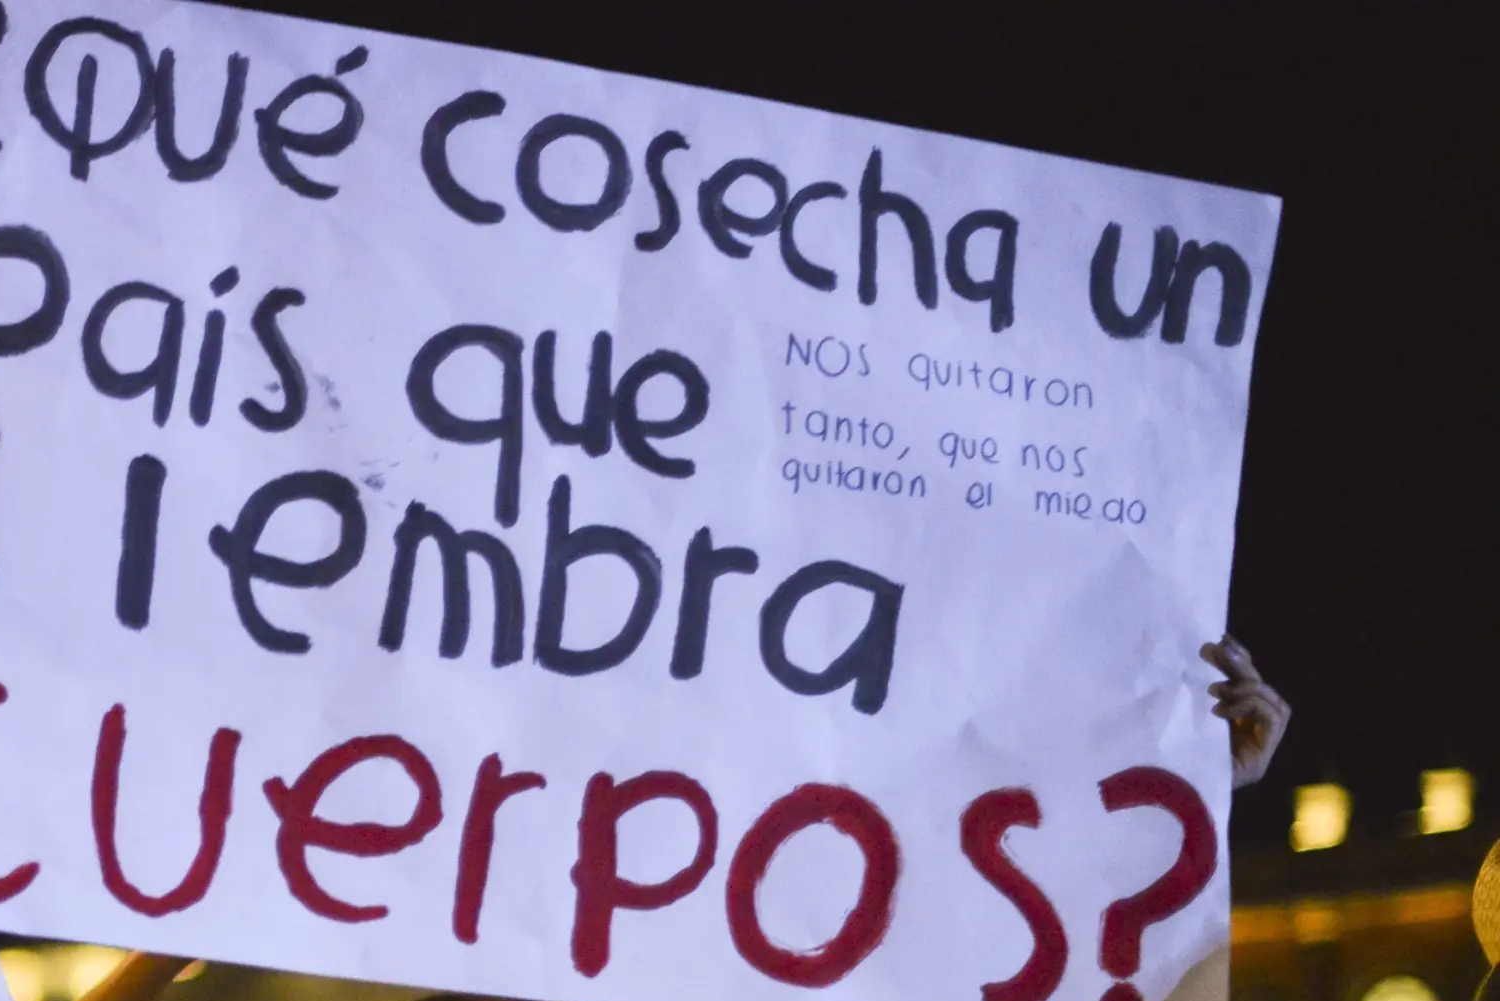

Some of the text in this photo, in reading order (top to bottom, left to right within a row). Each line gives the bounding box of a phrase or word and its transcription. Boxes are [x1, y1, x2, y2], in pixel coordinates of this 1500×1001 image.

[421, 90, 1018, 332] cosecha
[1089, 220, 1252, 347] un
[908, 353, 1094, 409] quitaron
[406, 323, 710, 528] que
[781, 400, 1088, 477] tanto, que nos
[965, 482, 993, 511] el
